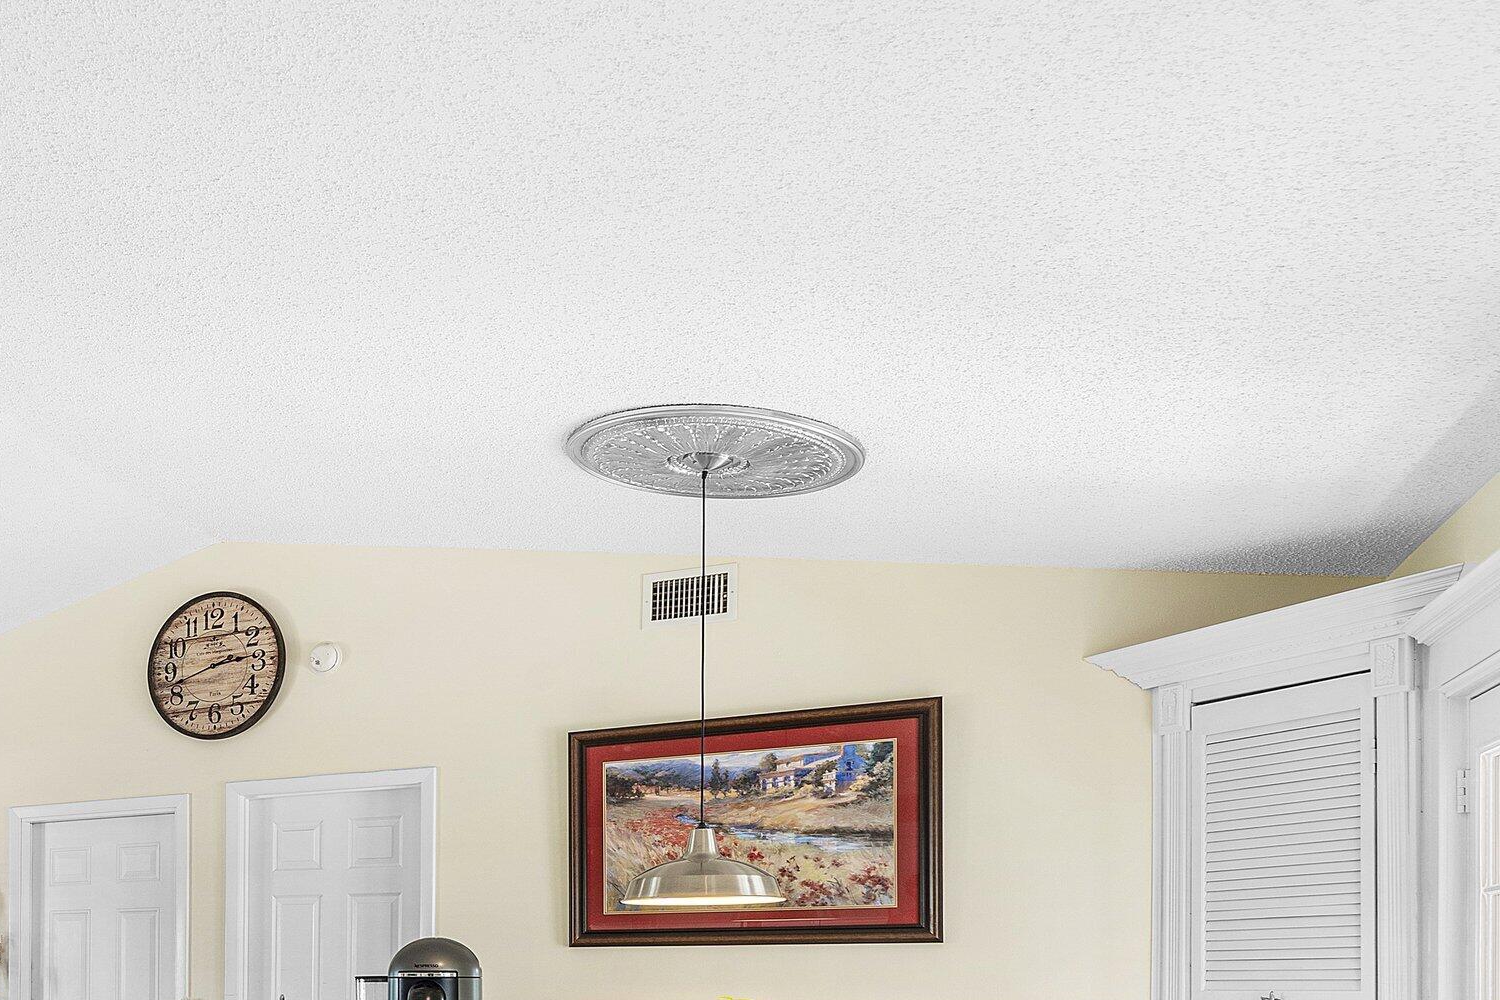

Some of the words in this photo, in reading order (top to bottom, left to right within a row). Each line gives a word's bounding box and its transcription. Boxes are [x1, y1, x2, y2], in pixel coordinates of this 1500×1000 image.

[185, 616, 198, 638] 11
[203, 608, 225, 631] 12
[232, 611, 241, 633] 1
[245, 625, 260, 648] 2
[168, 637, 186, 659] 10
[251, 648, 266, 672] 3
[164, 661, 177, 682] 9
[170, 684, 184, 706] 8
[242, 674, 259, 696] 4
[186, 700, 200, 721] 7
[208, 702, 222, 724] 6
[230, 693, 244, 716] 5
